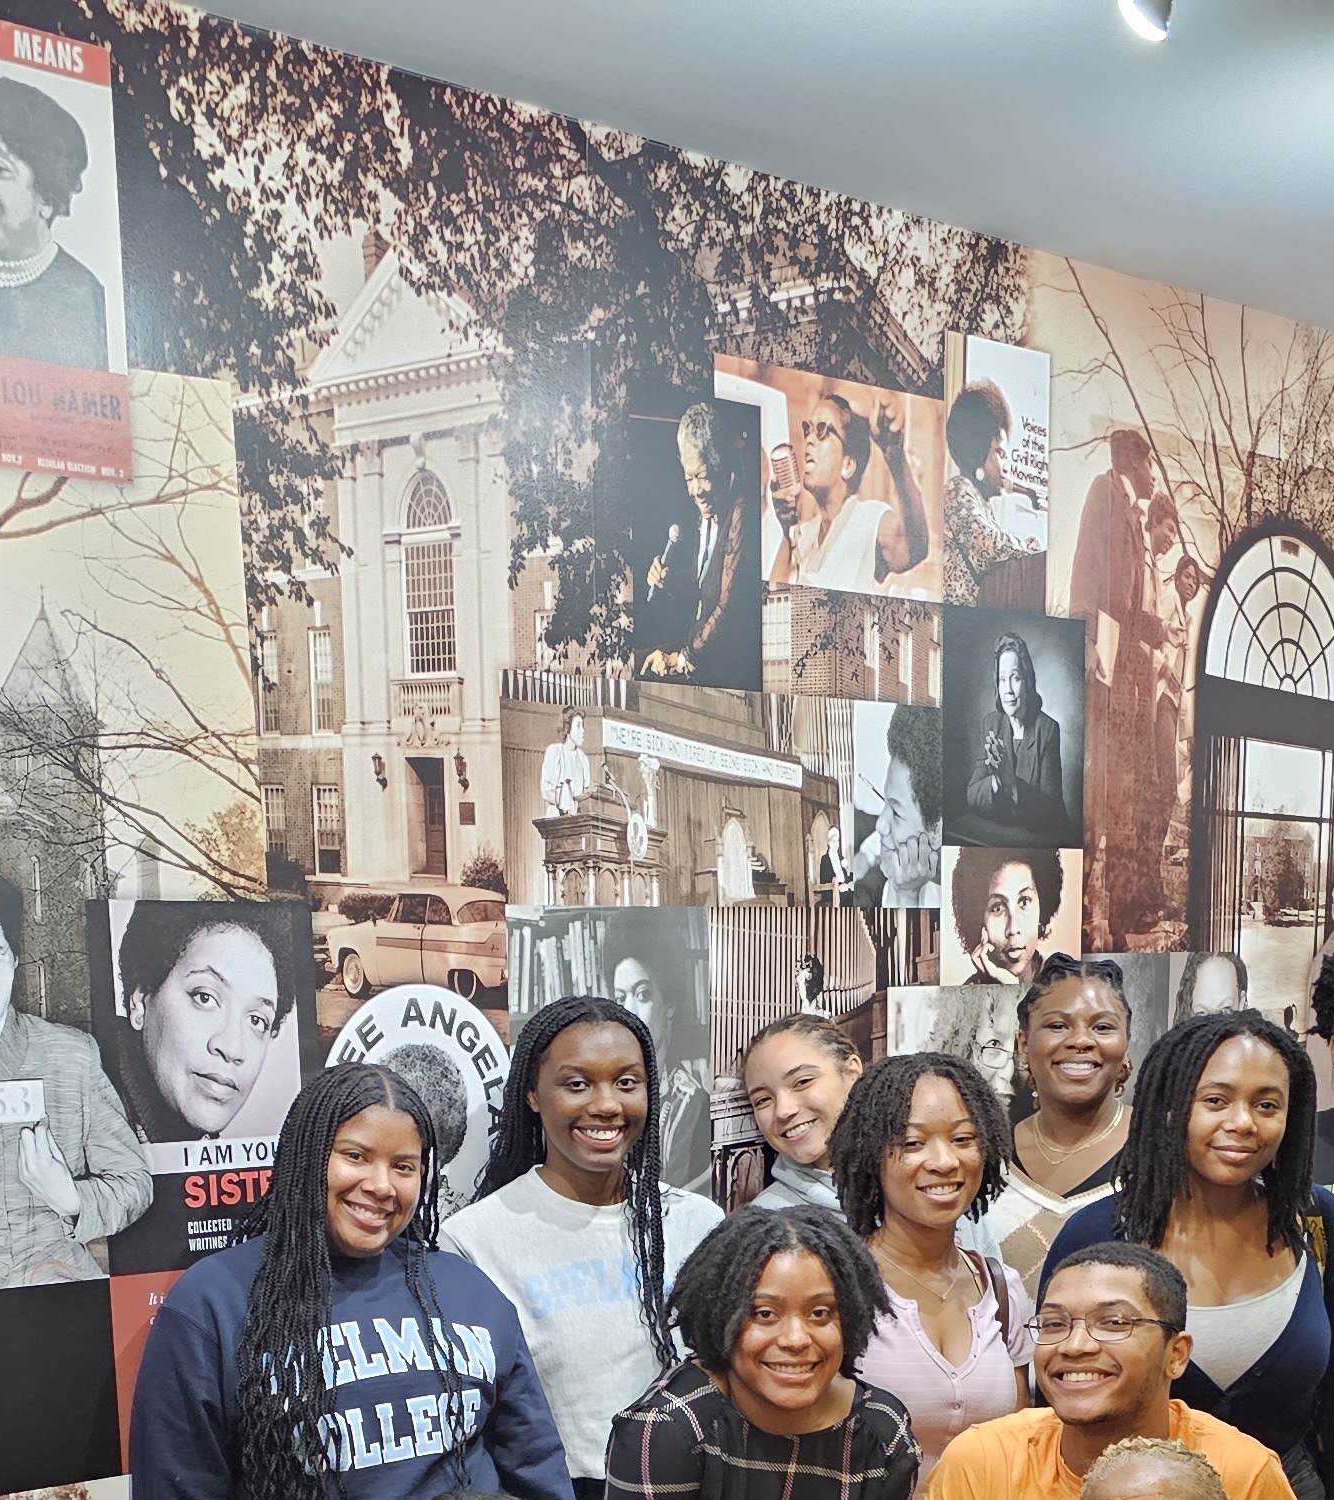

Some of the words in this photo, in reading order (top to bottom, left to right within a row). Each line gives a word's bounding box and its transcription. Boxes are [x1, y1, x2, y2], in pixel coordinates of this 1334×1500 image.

[14, 30, 84, 73] MEANS
[2, 378, 42, 406] LOU
[52, 388, 122, 421] HAMER
[1021, 415, 1047, 437] Voices
[1011, 448, 1029, 466] Civil
[1022, 434, 1031, 449] of
[1032, 436, 1045, 454] the
[335, 1013, 385, 1065] EE
[400, 996, 504, 1138] ANGELA
[183, 1147, 189, 1167] I
[199, 1144, 233, 1166] AM
[184, 1169, 275, 1209] SISTE
[187, 1218, 232, 1235] COLLECTED
[188, 1236, 228, 1252] WRITINGS
[269, 1316, 497, 1400] ELMAN
